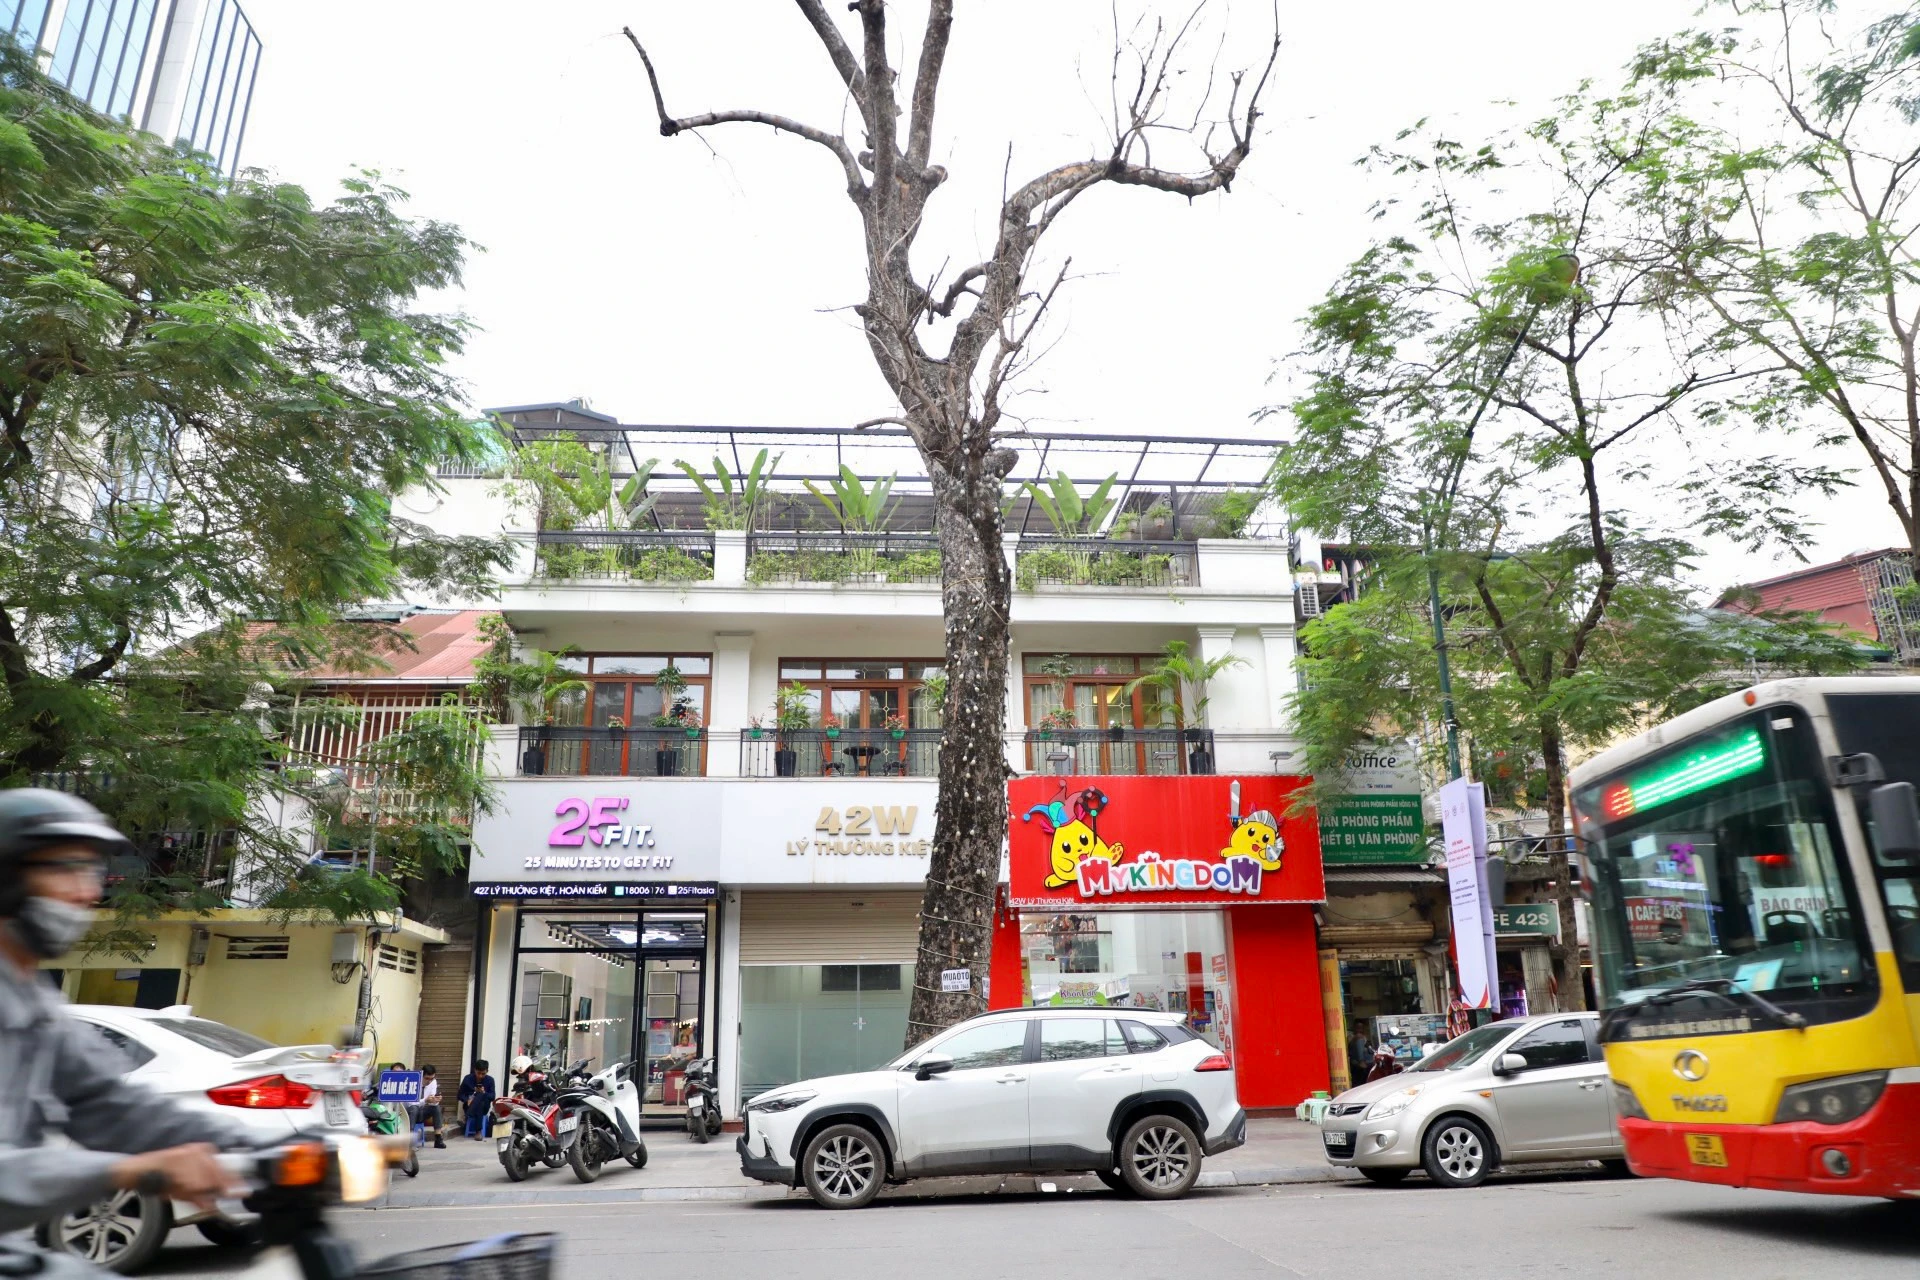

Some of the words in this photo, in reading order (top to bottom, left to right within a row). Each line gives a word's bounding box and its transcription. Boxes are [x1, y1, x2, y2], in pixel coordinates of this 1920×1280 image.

[815, 805, 918, 836] 42W
[1342, 813, 1379, 827] PHÒNG
[1382, 810, 1413, 827] PHẨM
[787, 837, 809, 856] LÝ
[815, 837, 894, 856] THƯỜNG
[1345, 833, 1356, 848] BỊ
[1358, 831, 1381, 845] VĂN
[523, 857, 542, 869] 25
[544, 856, 601, 870] MINUTES
[603, 857, 621, 869] TO
[623, 856, 649, 869] GET
[649, 856, 673, 869] FIT
[490, 884, 502, 895] LÝ
[502, 883, 539, 895] THƯỜNG
[559, 884, 587, 895] HOÀN
[586, 882, 607, 895] KIẾM
[1515, 912, 1549, 926] 42S
[381, 1077, 397, 1095] CẤM
[408, 1081, 418, 1095] XE
